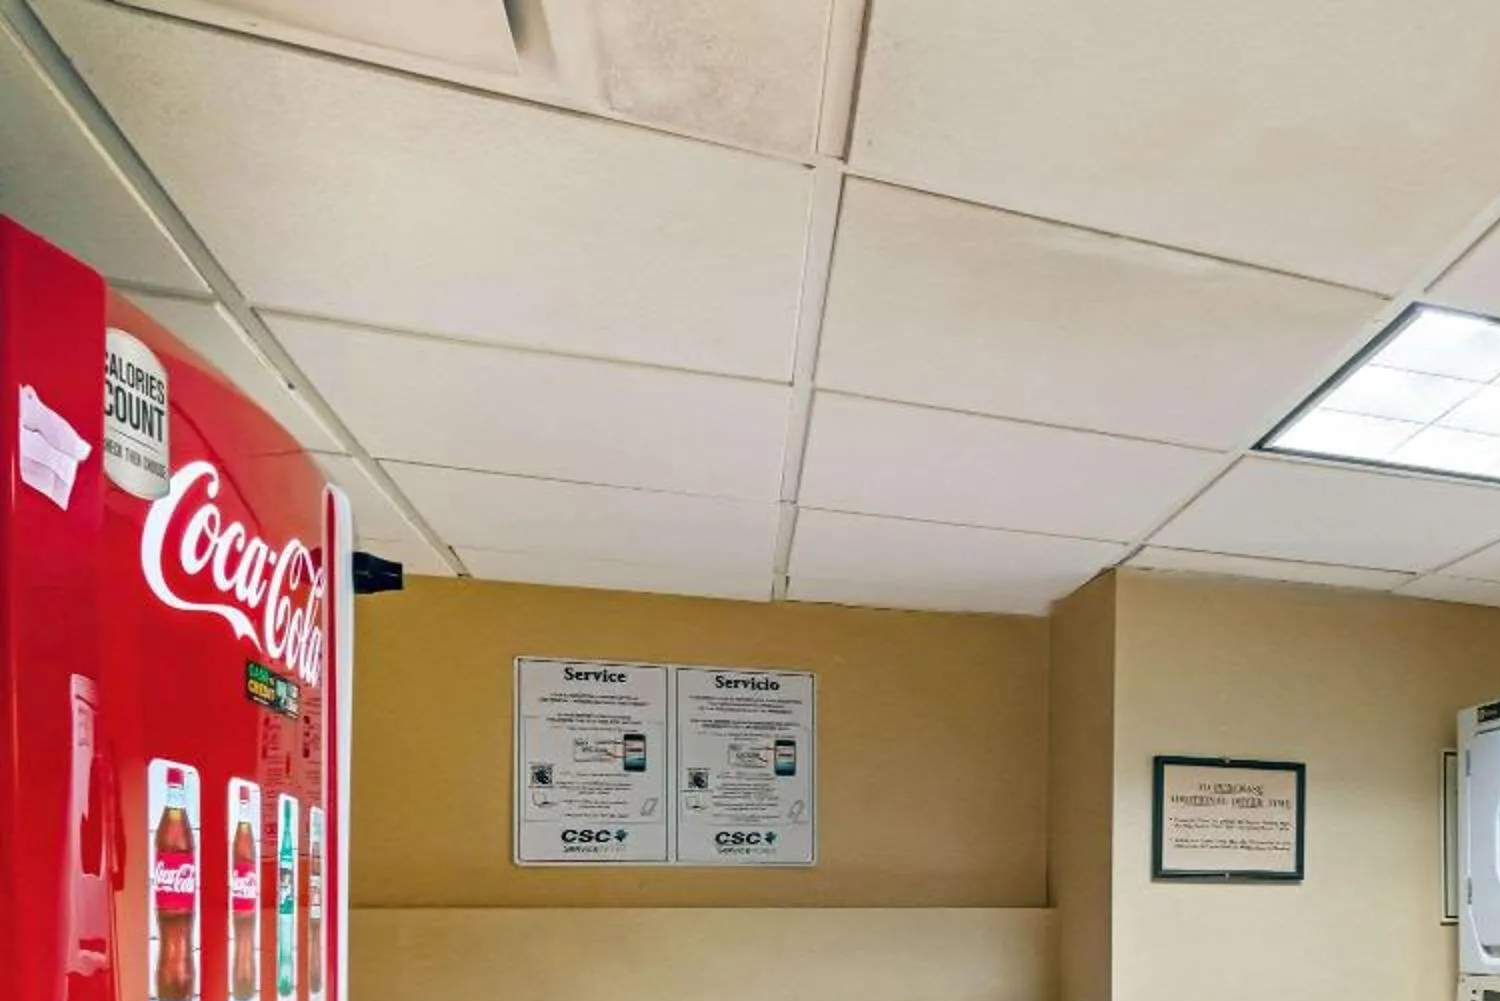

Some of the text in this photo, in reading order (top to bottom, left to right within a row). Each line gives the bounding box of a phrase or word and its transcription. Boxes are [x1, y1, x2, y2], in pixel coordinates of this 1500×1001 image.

[563, 667, 627, 683] Service
[715, 675, 781, 691] Servicio
[561, 829, 612, 843] CSC
[715, 831, 762, 845] CSC
